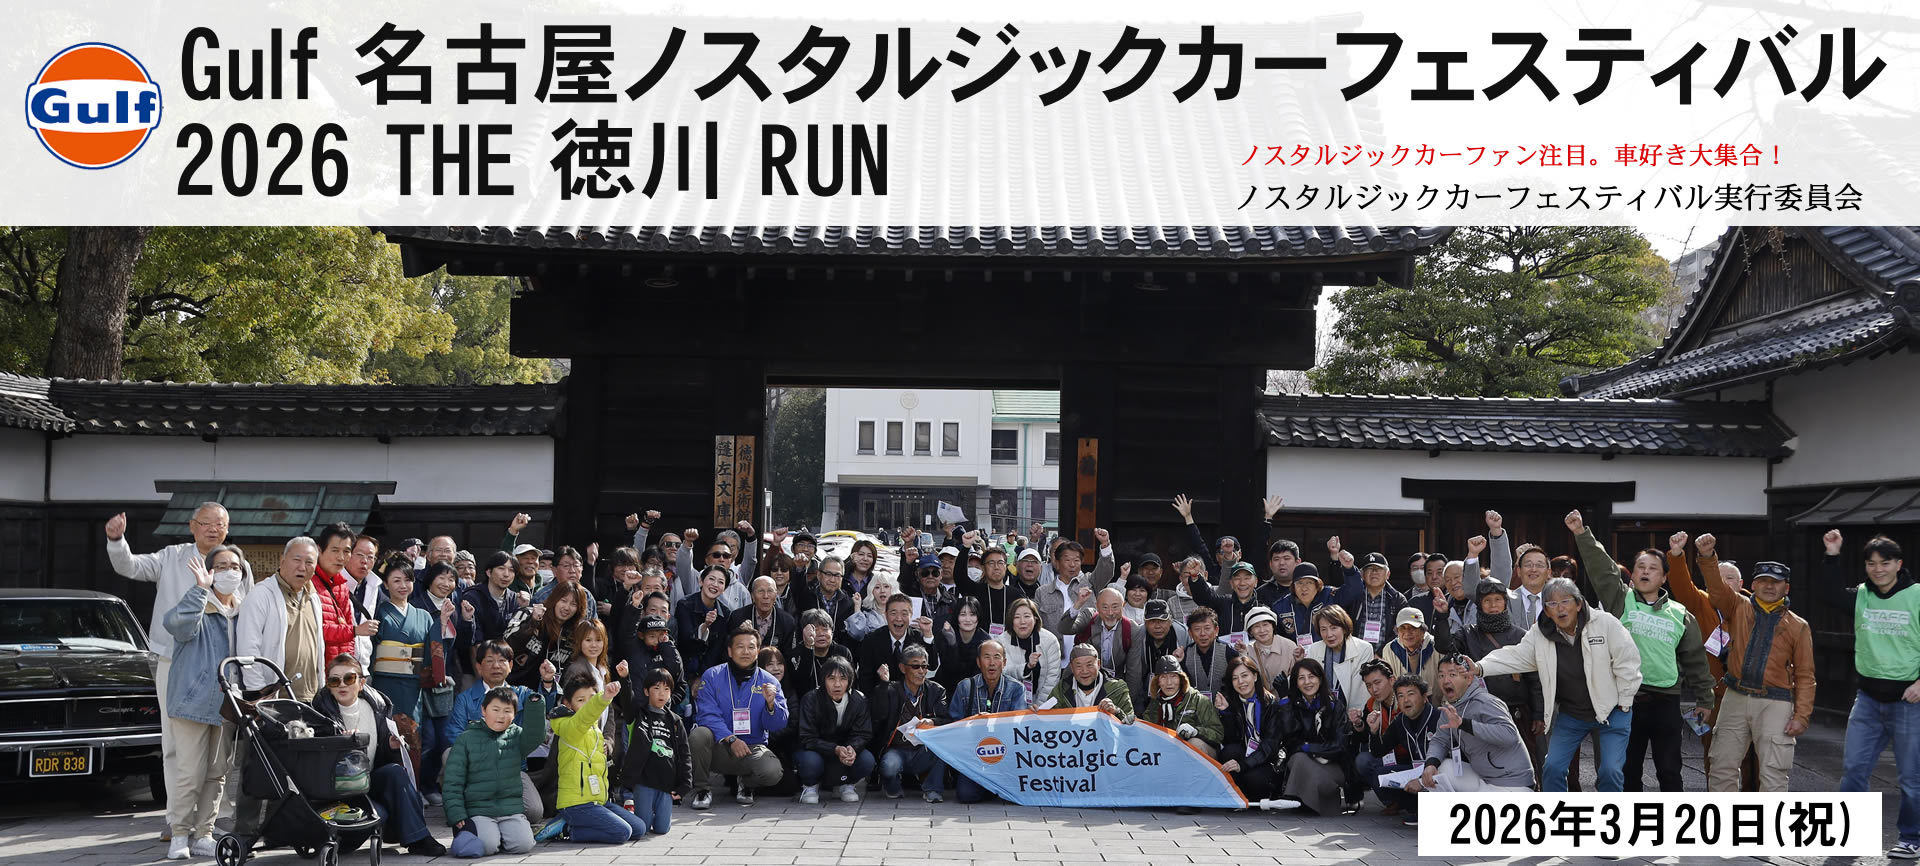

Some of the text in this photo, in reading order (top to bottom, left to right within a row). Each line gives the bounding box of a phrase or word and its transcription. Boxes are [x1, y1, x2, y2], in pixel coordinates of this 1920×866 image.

[1628, 611, 1675, 629] STAFF
[1013, 726, 1097, 749] Nagoya
[976, 745, 1005, 756] Gulf
[35, 756, 85, 772] RDR 838
[1016, 748, 1161, 772] Nostalgic Car
[1018, 774, 1096, 793] Festival
